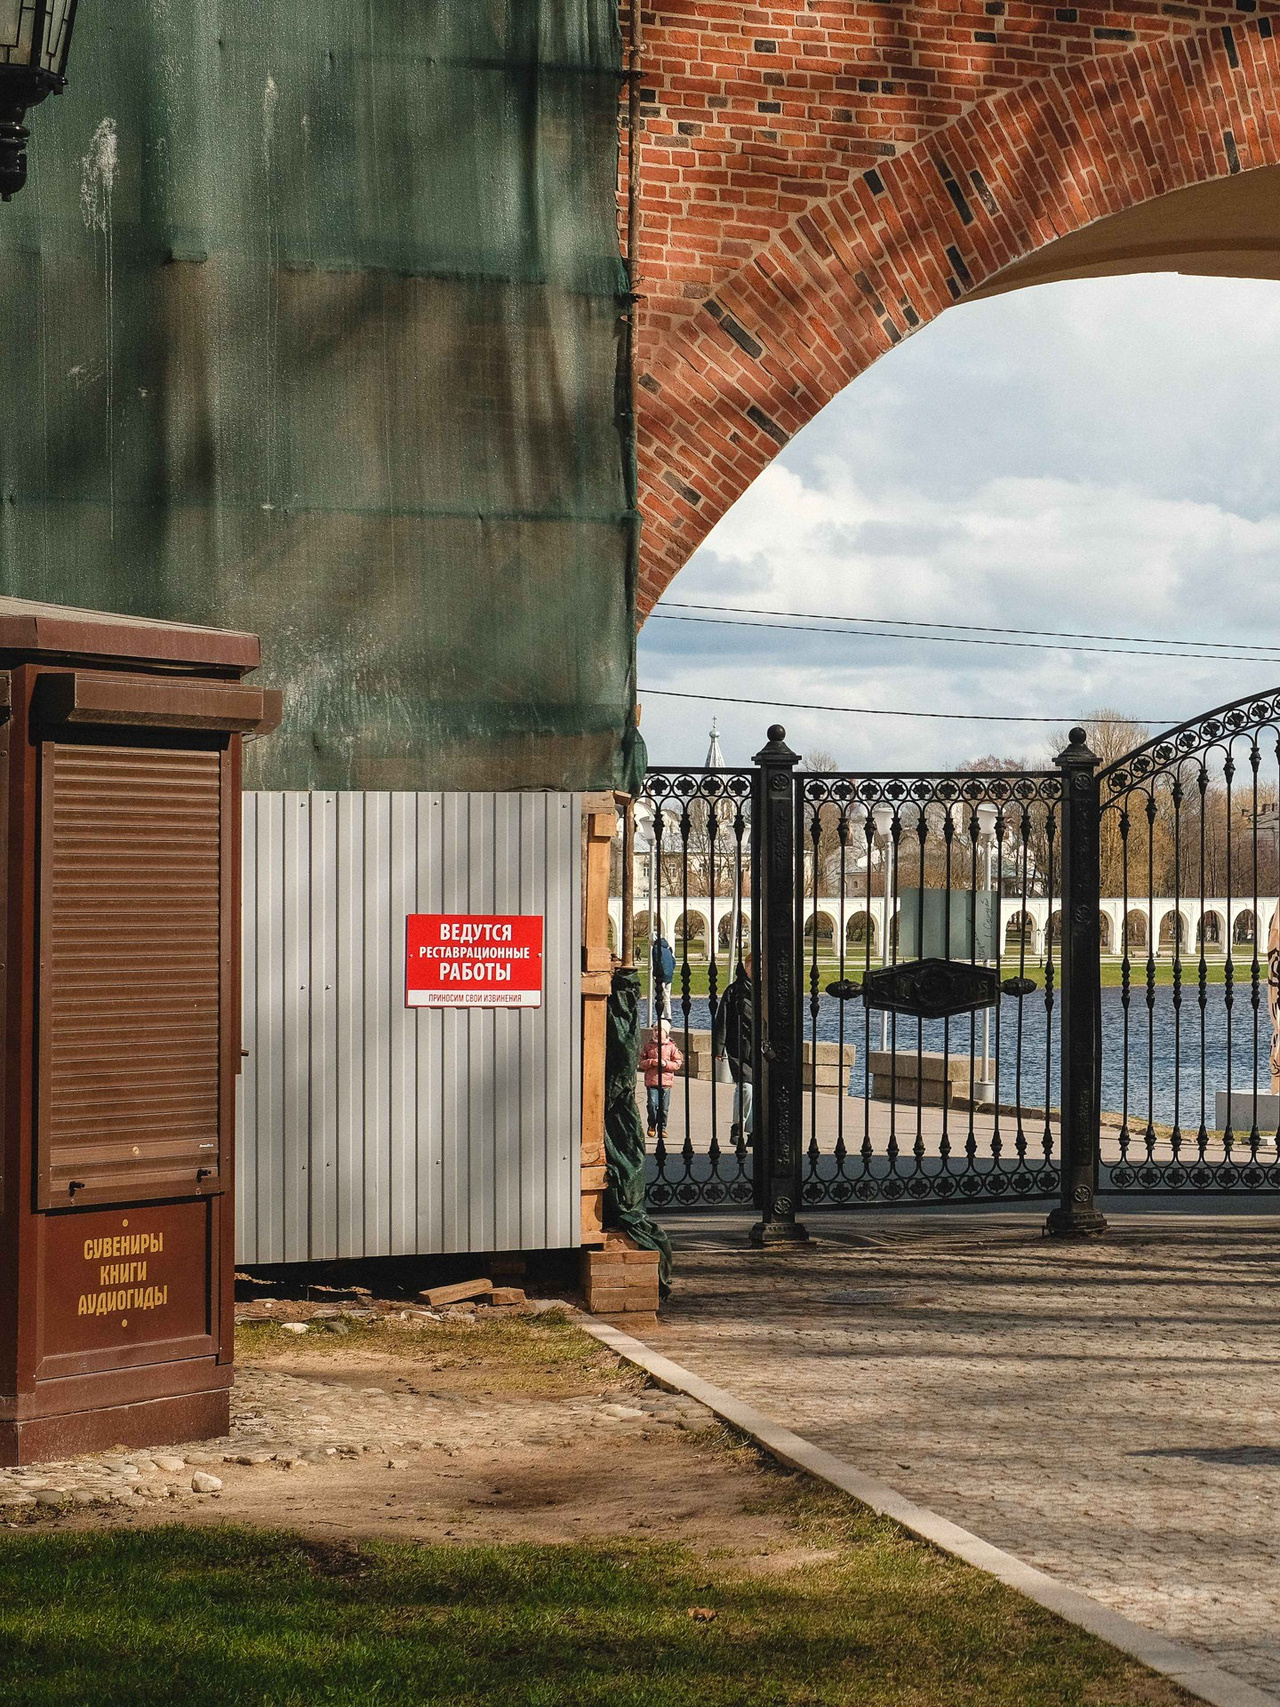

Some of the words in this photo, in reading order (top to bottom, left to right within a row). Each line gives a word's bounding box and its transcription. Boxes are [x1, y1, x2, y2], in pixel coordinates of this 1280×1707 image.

[440, 923, 512, 944] ВЕДУТСЯ
[419, 946, 530, 960] РЕСТАВРАЦИОННЫЕ
[439, 962, 511, 981] РАБОТЫ
[428, 994, 464, 1002] ПРИНОСИМ
[465, 994, 482, 1003] СВОИ
[483, 994, 522, 1003] ИЗВИНЕНИЯ
[83, 1232, 164, 1260] СУВЕНИРЫ
[100, 1261, 147, 1286] КНИГИ
[78, 1285, 168, 1316] АУДИОГИДЫ
